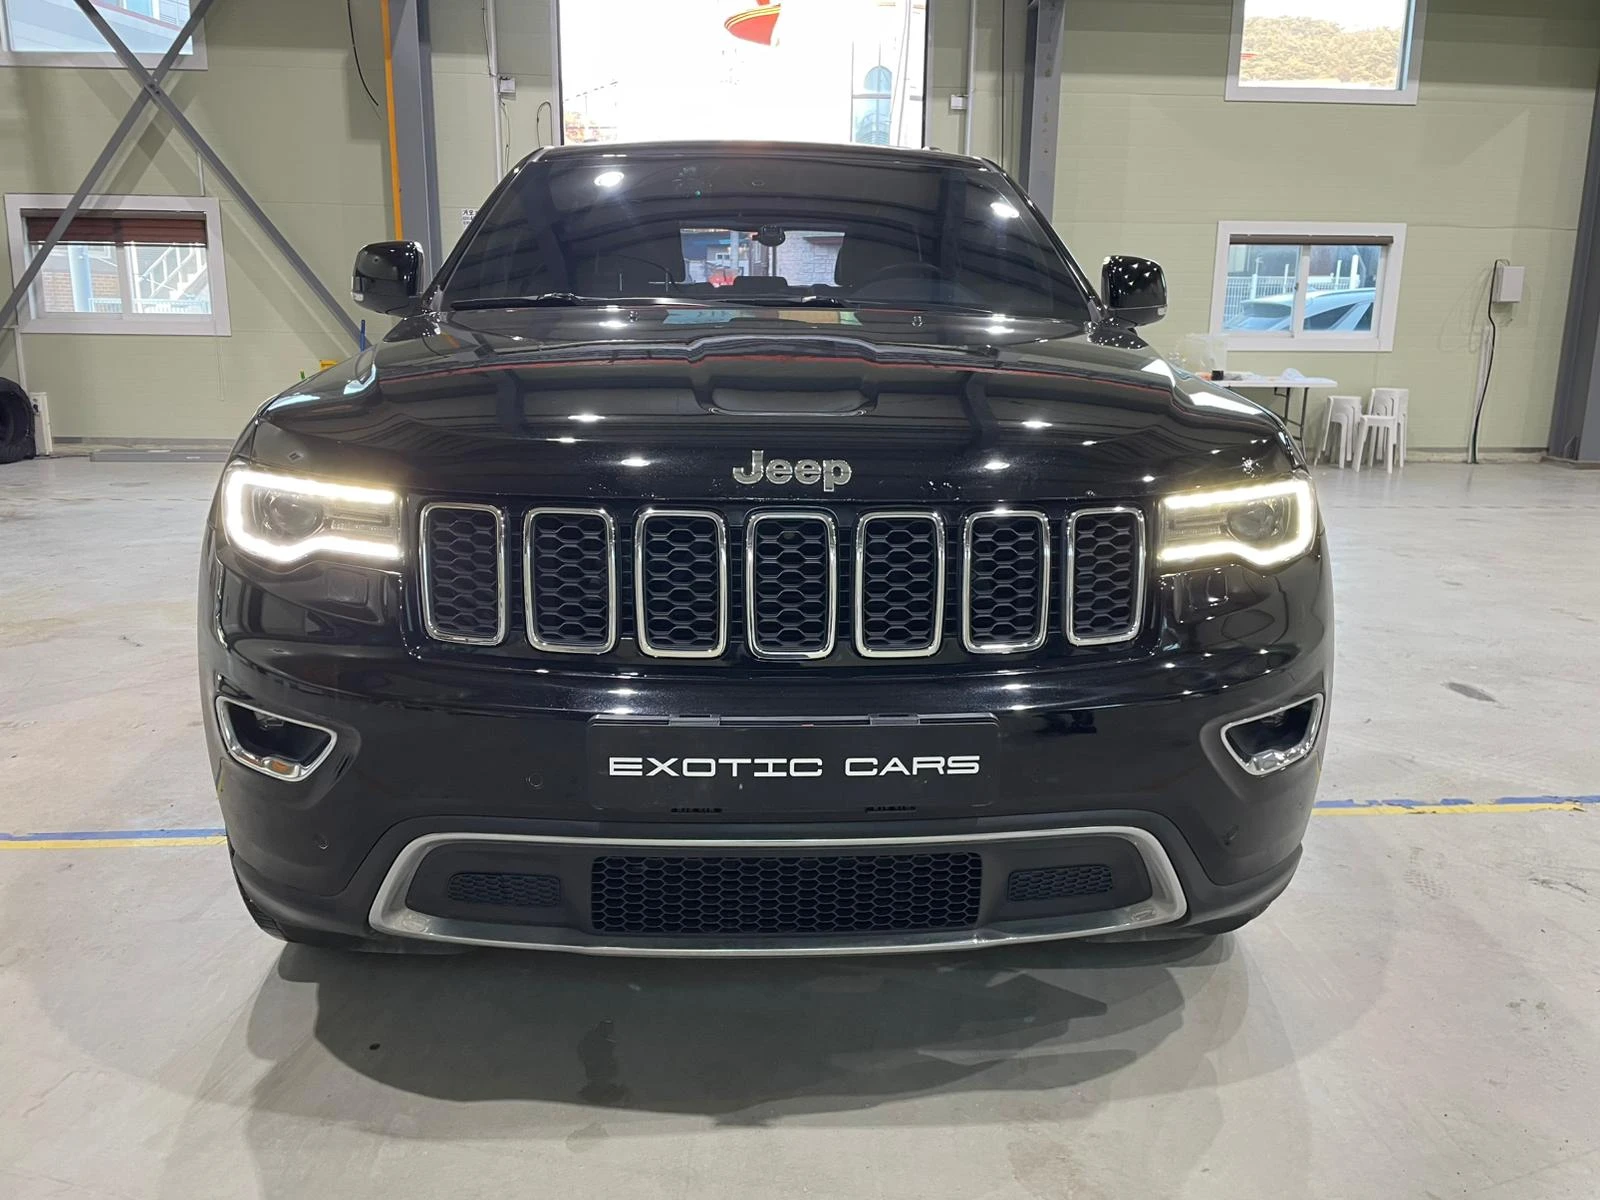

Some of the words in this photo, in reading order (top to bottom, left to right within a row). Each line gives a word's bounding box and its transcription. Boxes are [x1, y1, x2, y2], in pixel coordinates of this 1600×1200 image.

[732, 450, 852, 492] Jeep
[608, 757, 823, 777] EXOTIC
[844, 755, 981, 776] CARS
